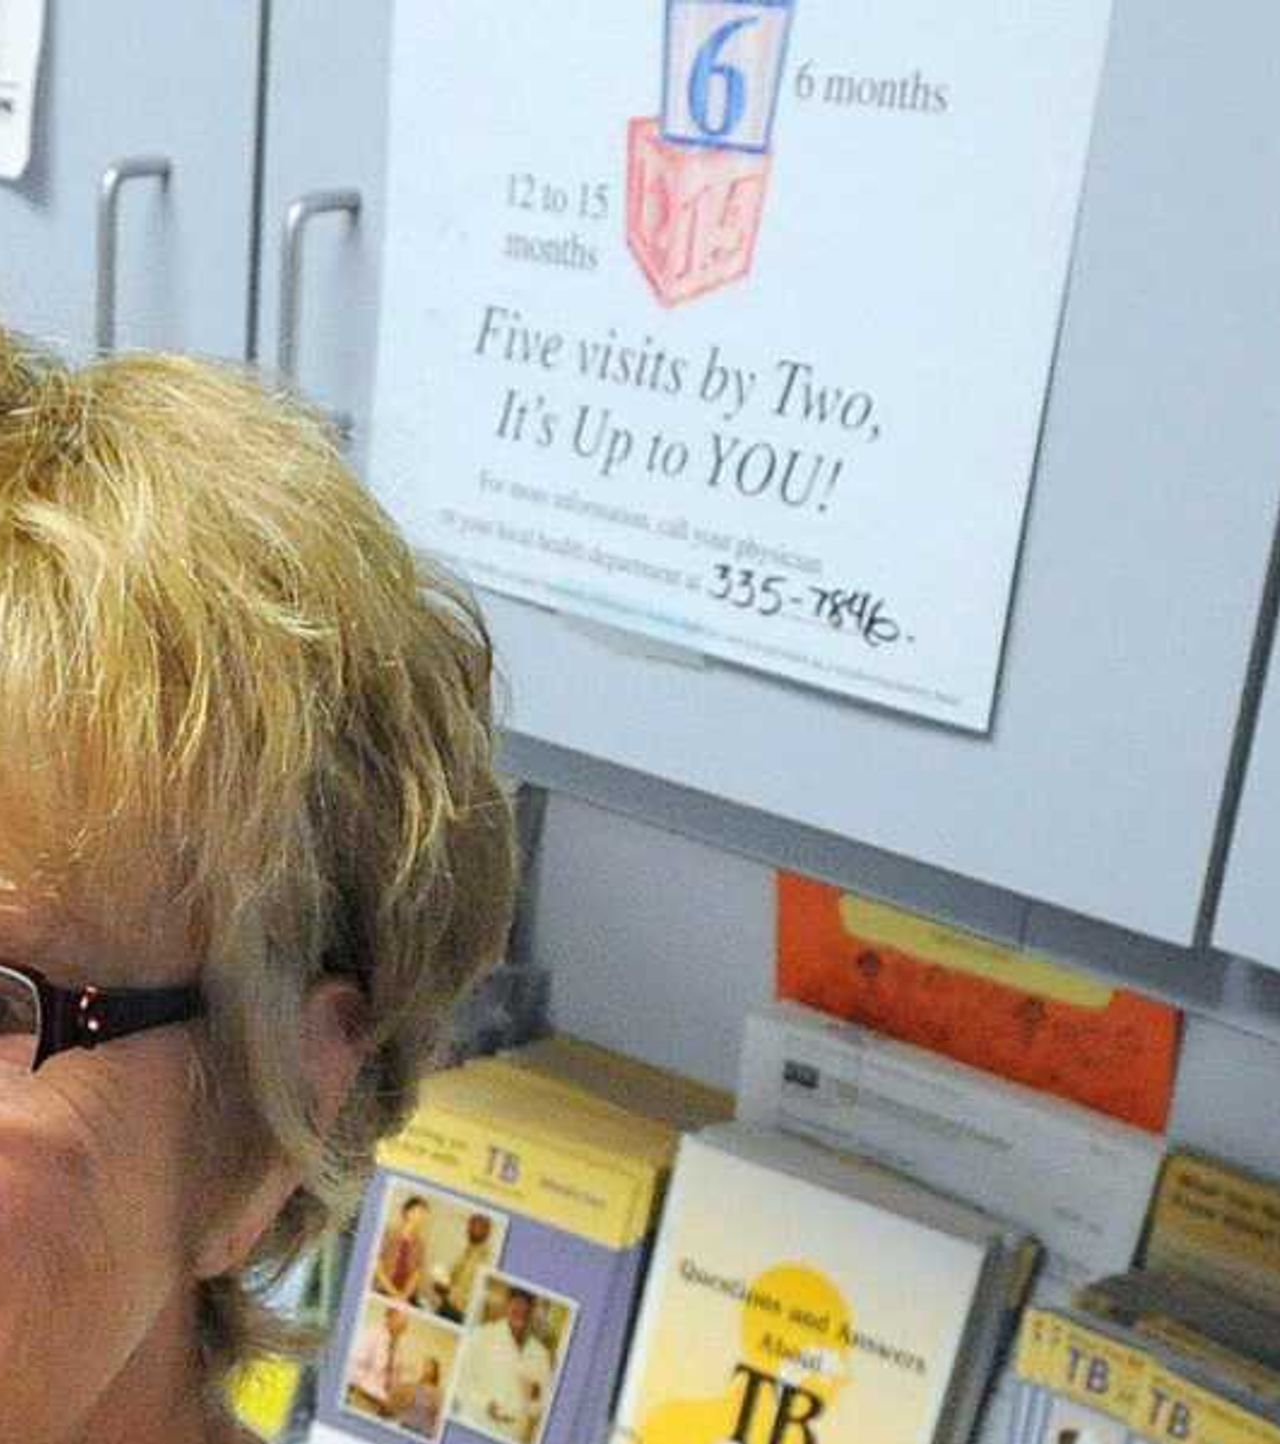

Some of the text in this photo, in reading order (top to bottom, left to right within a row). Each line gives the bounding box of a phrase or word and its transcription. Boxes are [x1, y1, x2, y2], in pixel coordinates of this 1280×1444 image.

[689, 16, 760, 137] 6
[794, 61, 950, 115] 6 months
[505, 172, 609, 220] 12 to 15
[503, 228, 600, 271] months
[475, 305, 881, 442] Five visits by Two,
[496, 388, 844, 513] It's Up to YOU!
[479, 470, 510, 497] For
[655, 512, 689, 541] call
[693, 527, 730, 556] your
[496, 519, 535, 546] local
[537, 527, 583, 559] health
[587, 541, 681, 589] department
[482, 1142, 522, 1186] TB
[678, 1256, 927, 1376] Questions and Answers
[1065, 1346, 1111, 1395] TB
[1147, 1386, 1191, 1440] TB
